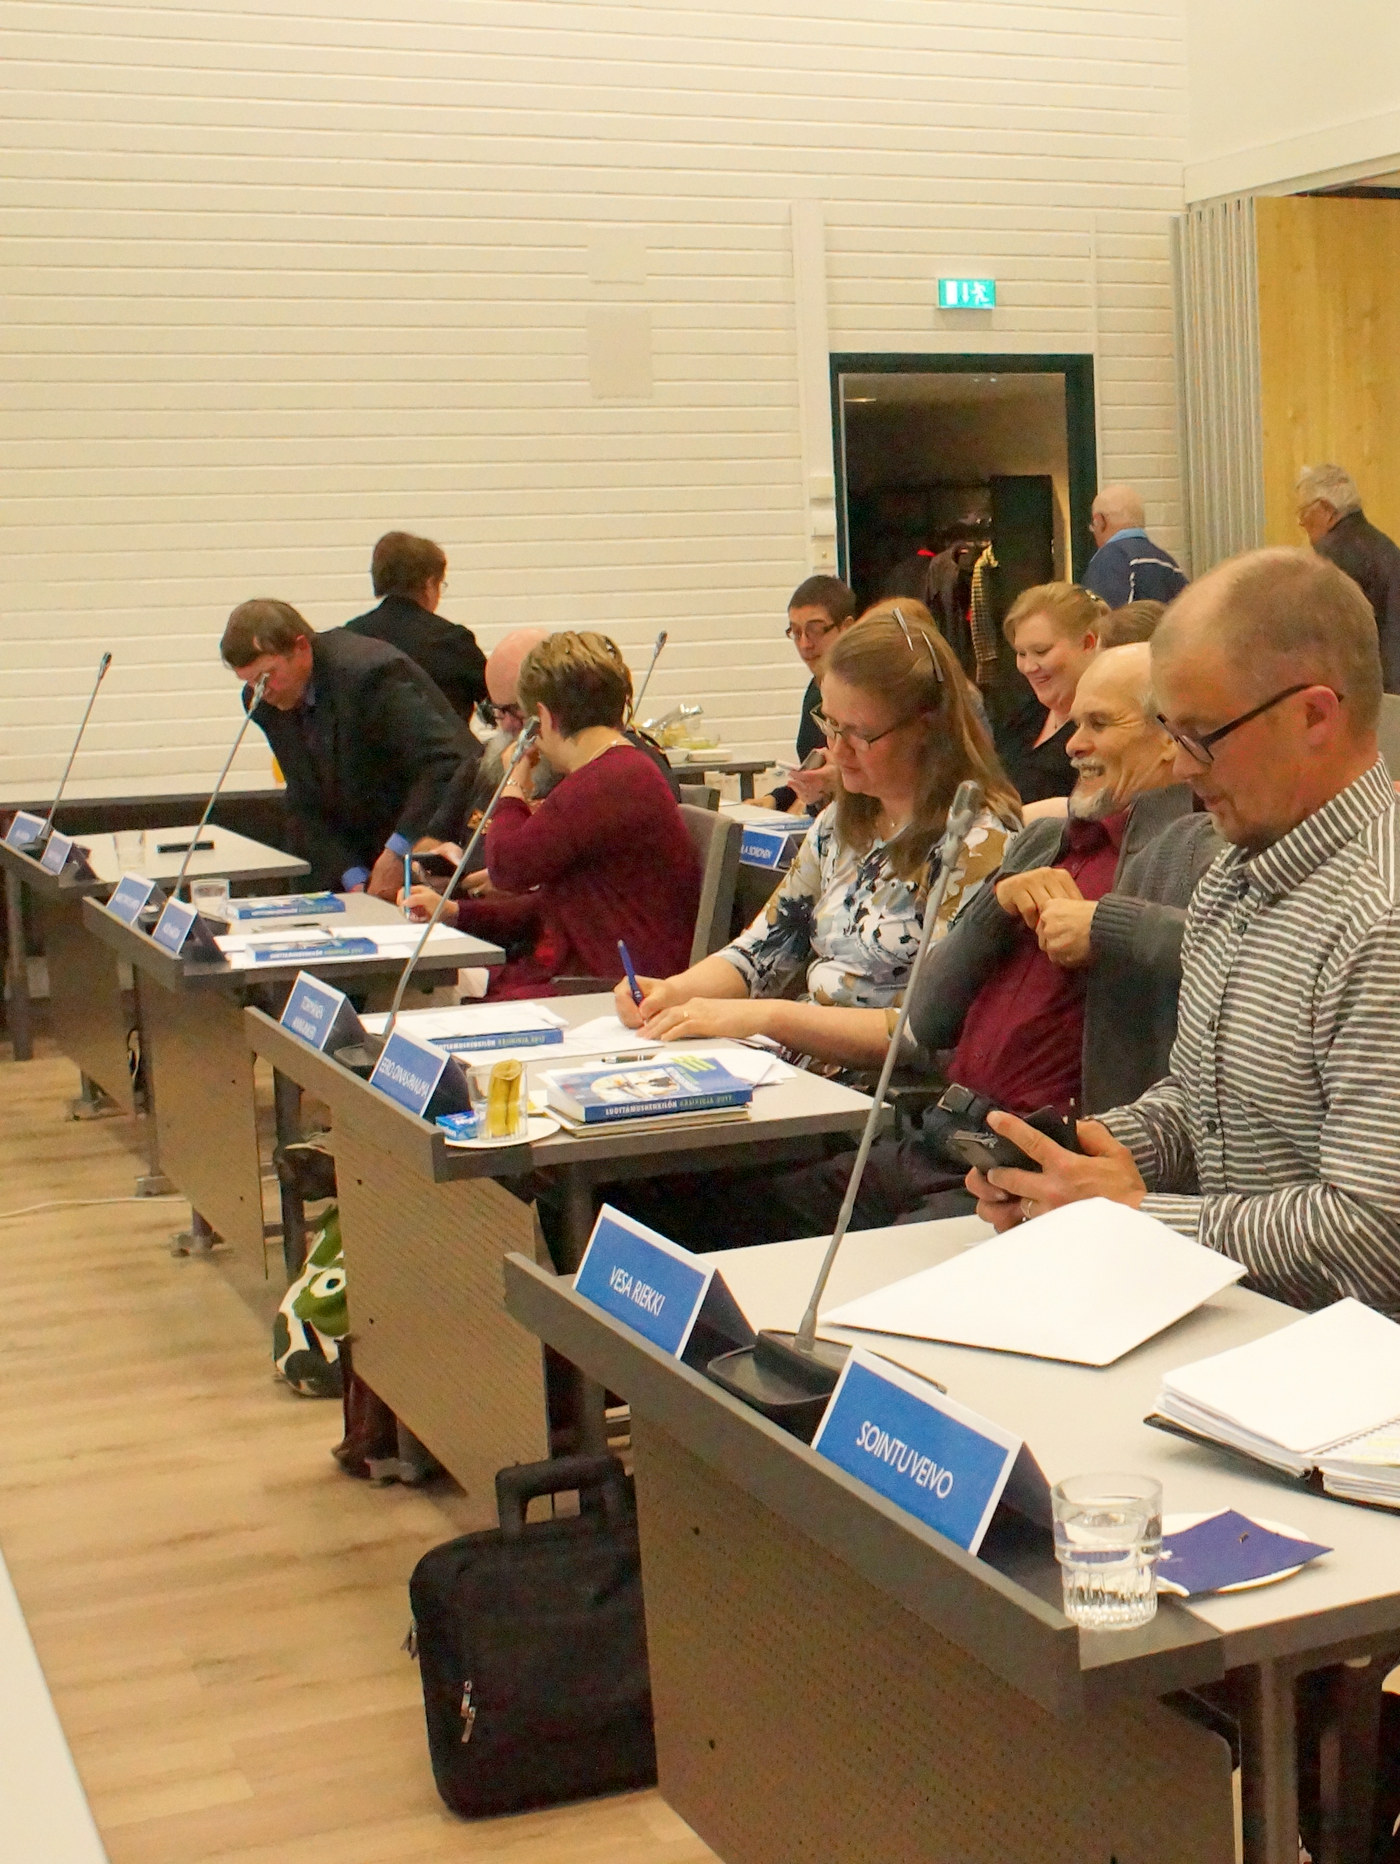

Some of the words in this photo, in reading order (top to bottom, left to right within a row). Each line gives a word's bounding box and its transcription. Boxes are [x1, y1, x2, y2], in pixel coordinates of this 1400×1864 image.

[609, 1265, 634, 1298] VESA
[630, 1279, 667, 1317] RIEKKI
[856, 1420, 916, 1474] SOINTU
[909, 1451, 954, 1499] VEIVO
